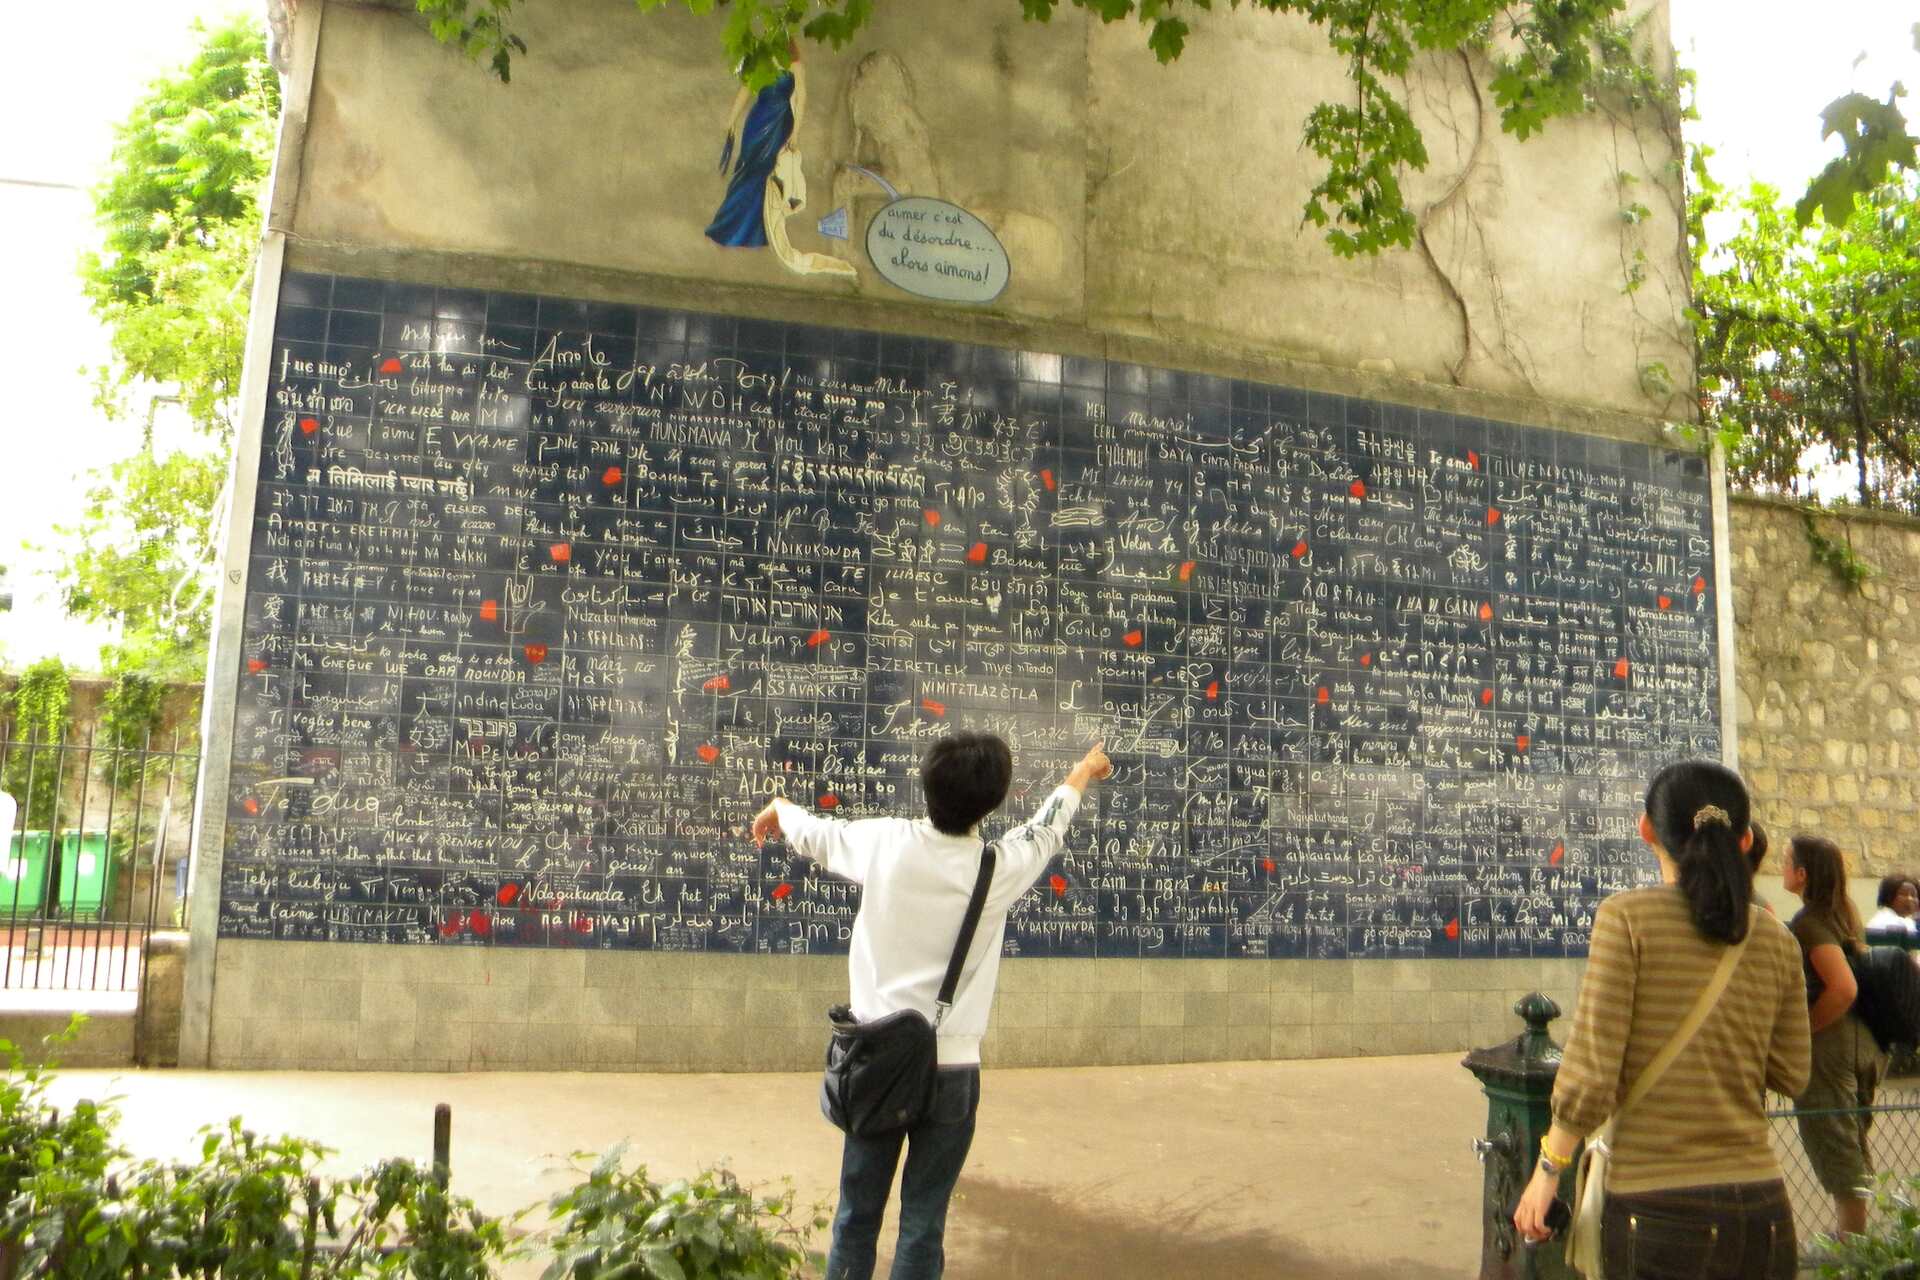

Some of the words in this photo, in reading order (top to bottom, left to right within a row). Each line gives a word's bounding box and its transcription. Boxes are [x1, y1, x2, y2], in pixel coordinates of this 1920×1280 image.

[888, 208, 926, 221] aimer
[934, 210, 963, 225] c'est
[879, 222, 894, 239] du
[892, 248, 928, 272] alors
